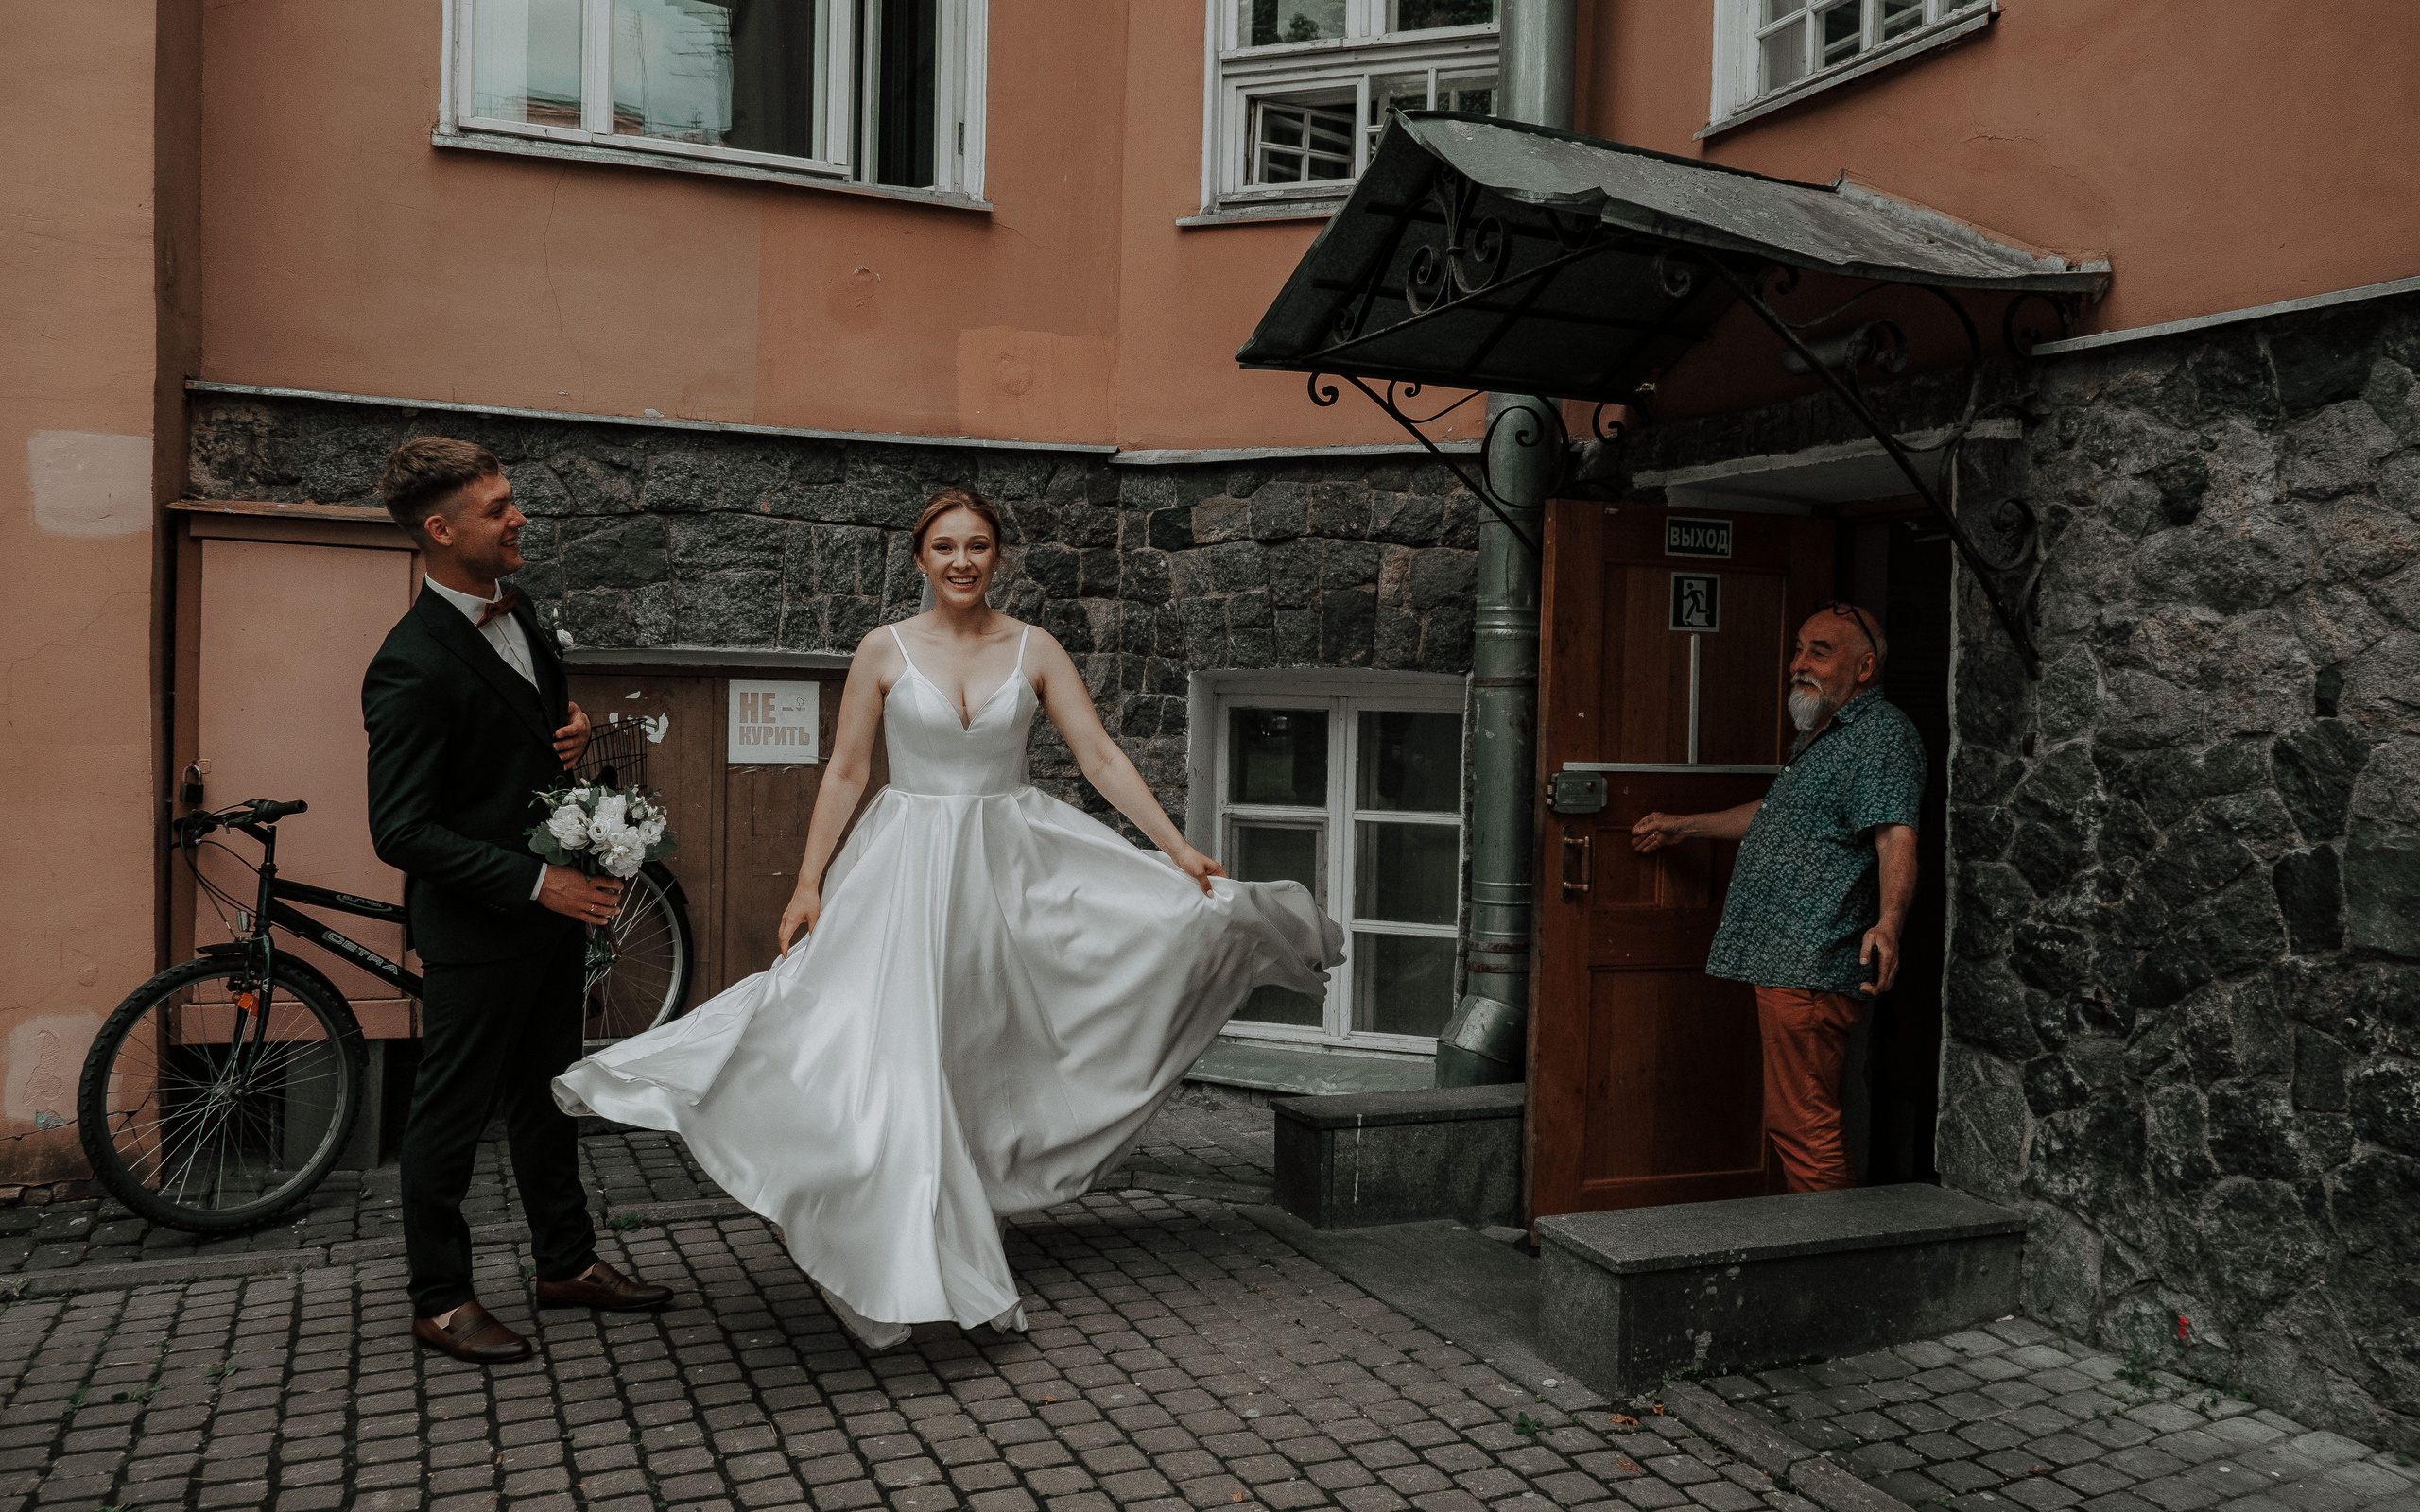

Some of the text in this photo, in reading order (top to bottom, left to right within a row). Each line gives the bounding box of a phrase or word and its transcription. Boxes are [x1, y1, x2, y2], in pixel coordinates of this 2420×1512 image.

[1670, 526, 1728, 553] ВЫХОД
[739, 692, 776, 724] НЕ
[738, 726, 810, 746] КУРИТЬ
[327, 932, 398, 975] CETRA
